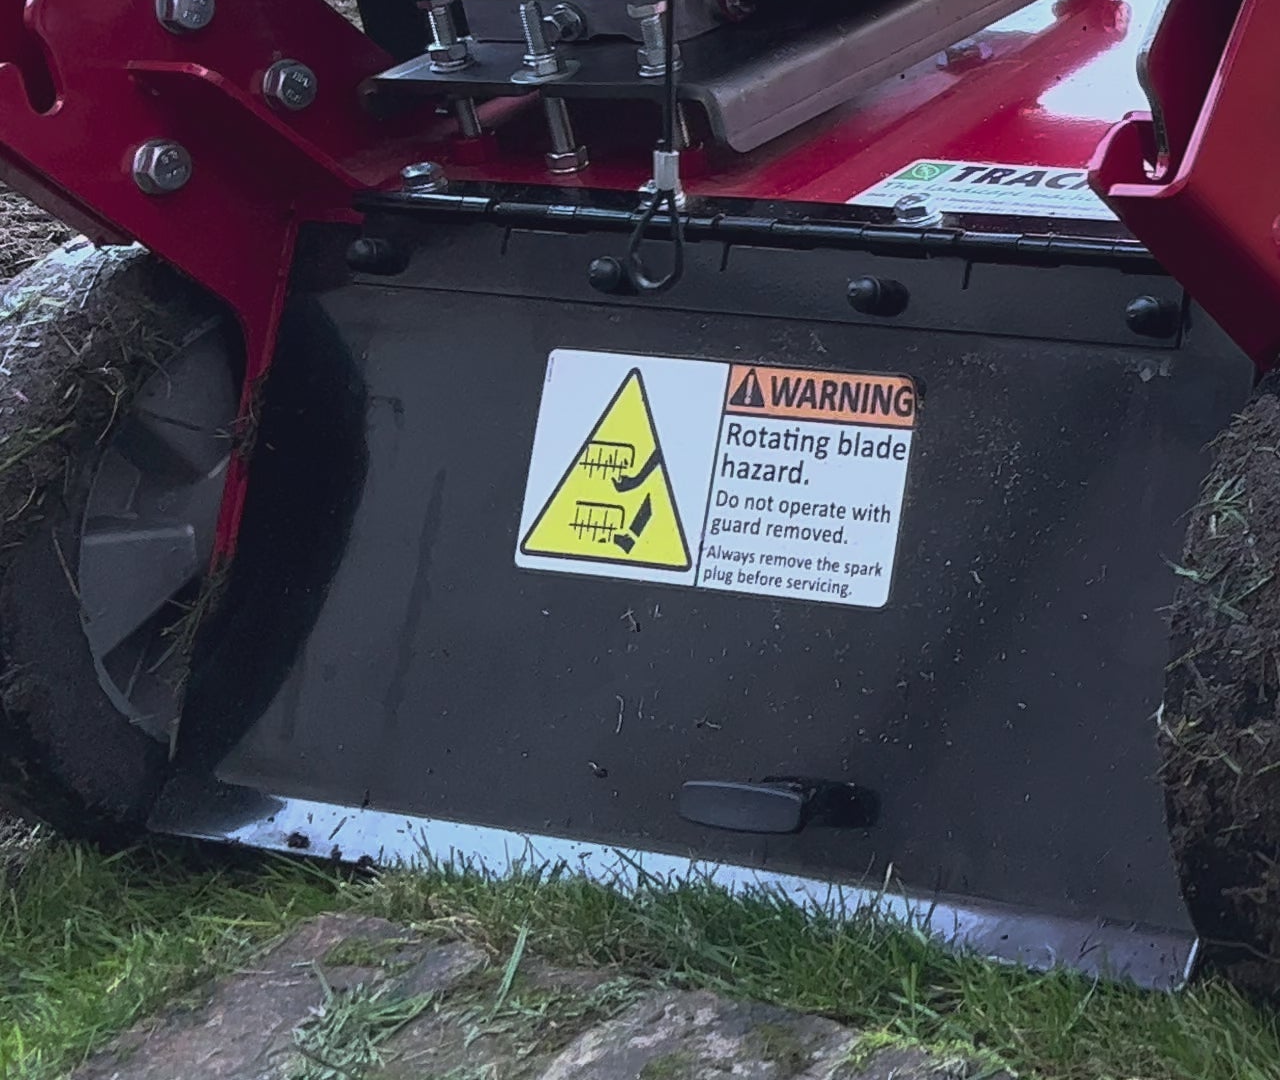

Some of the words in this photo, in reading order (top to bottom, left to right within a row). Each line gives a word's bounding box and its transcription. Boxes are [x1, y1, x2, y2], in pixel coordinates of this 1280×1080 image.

[770, 375, 914, 417] WARNING
[726, 422, 830, 460] Rotating
[837, 430, 907, 461] blade
[720, 452, 810, 486] hazard.
[715, 489, 739, 509] Do
[744, 495, 774, 512] not
[778, 499, 847, 520] operate
[852, 503, 892, 524] with
[710, 517, 762, 536] guard
[766, 521, 849, 545] removed.
[706, 544, 755, 565] Always
[759, 551, 812, 570] remove
[816, 556, 841, 573] the
[843, 561, 884, 578] spark
[703, 565, 733, 586] plug
[737, 569, 783, 589] before
[786, 575, 853, 599] servicing.
